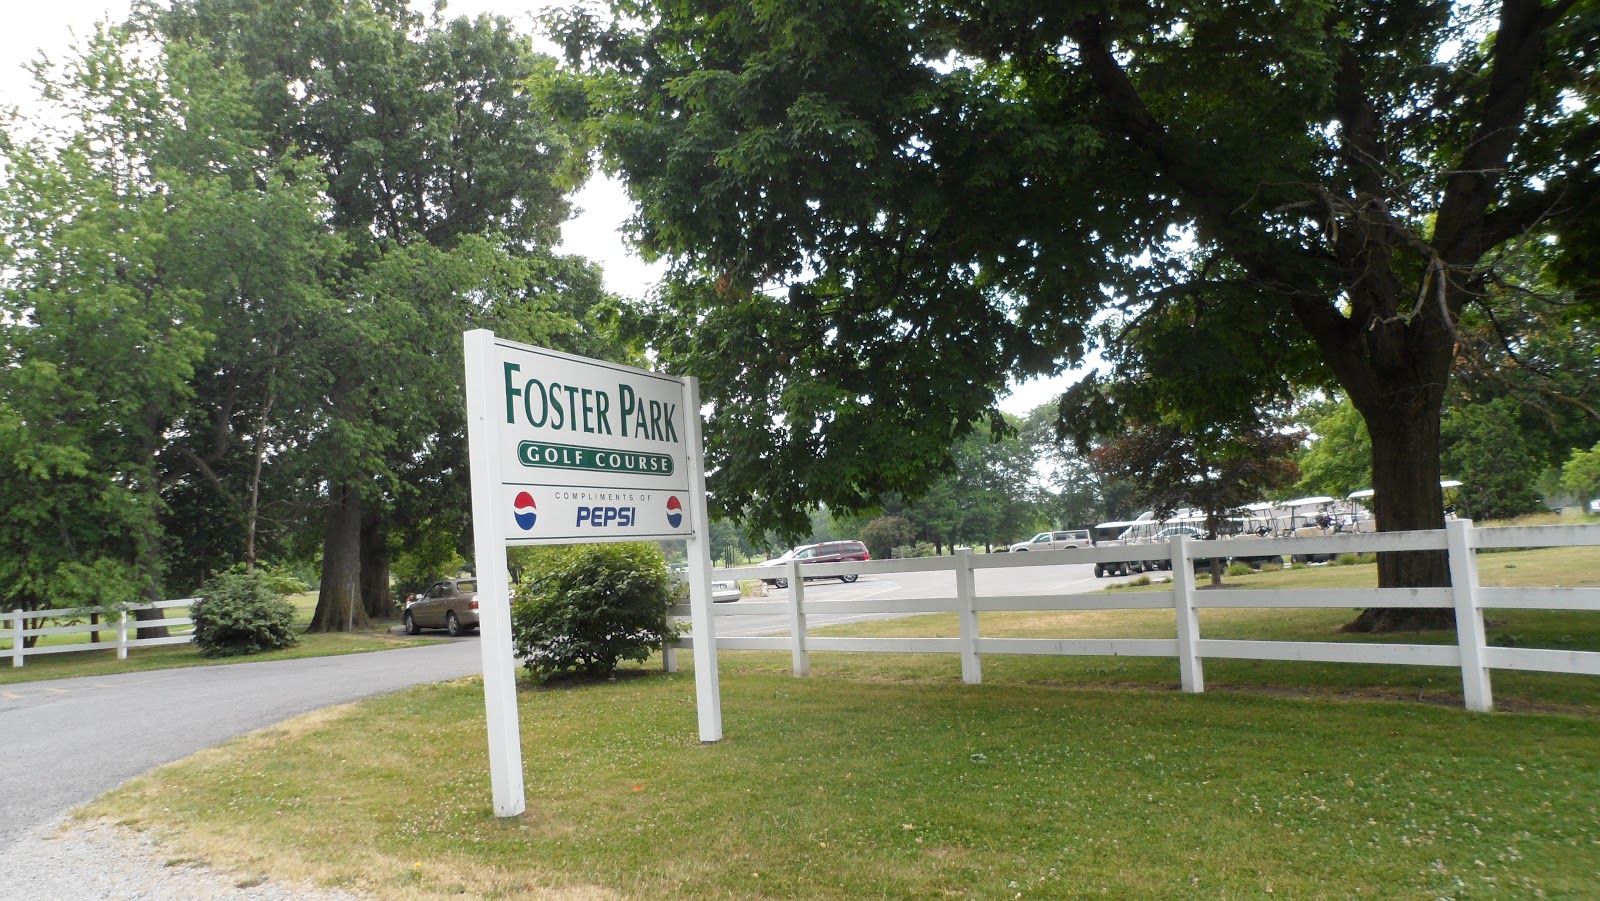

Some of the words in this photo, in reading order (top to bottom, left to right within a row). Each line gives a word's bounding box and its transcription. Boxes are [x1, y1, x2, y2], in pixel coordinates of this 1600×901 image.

[503, 361, 613, 436] FOSTER
[618, 383, 679, 444] PARK
[526, 446, 584, 466] GOLF
[595, 452, 669, 472] COURSE
[555, 491, 634, 502] COMPLIMENTS
[640, 494, 652, 502] OF
[575, 506, 636, 528] PEPSI
